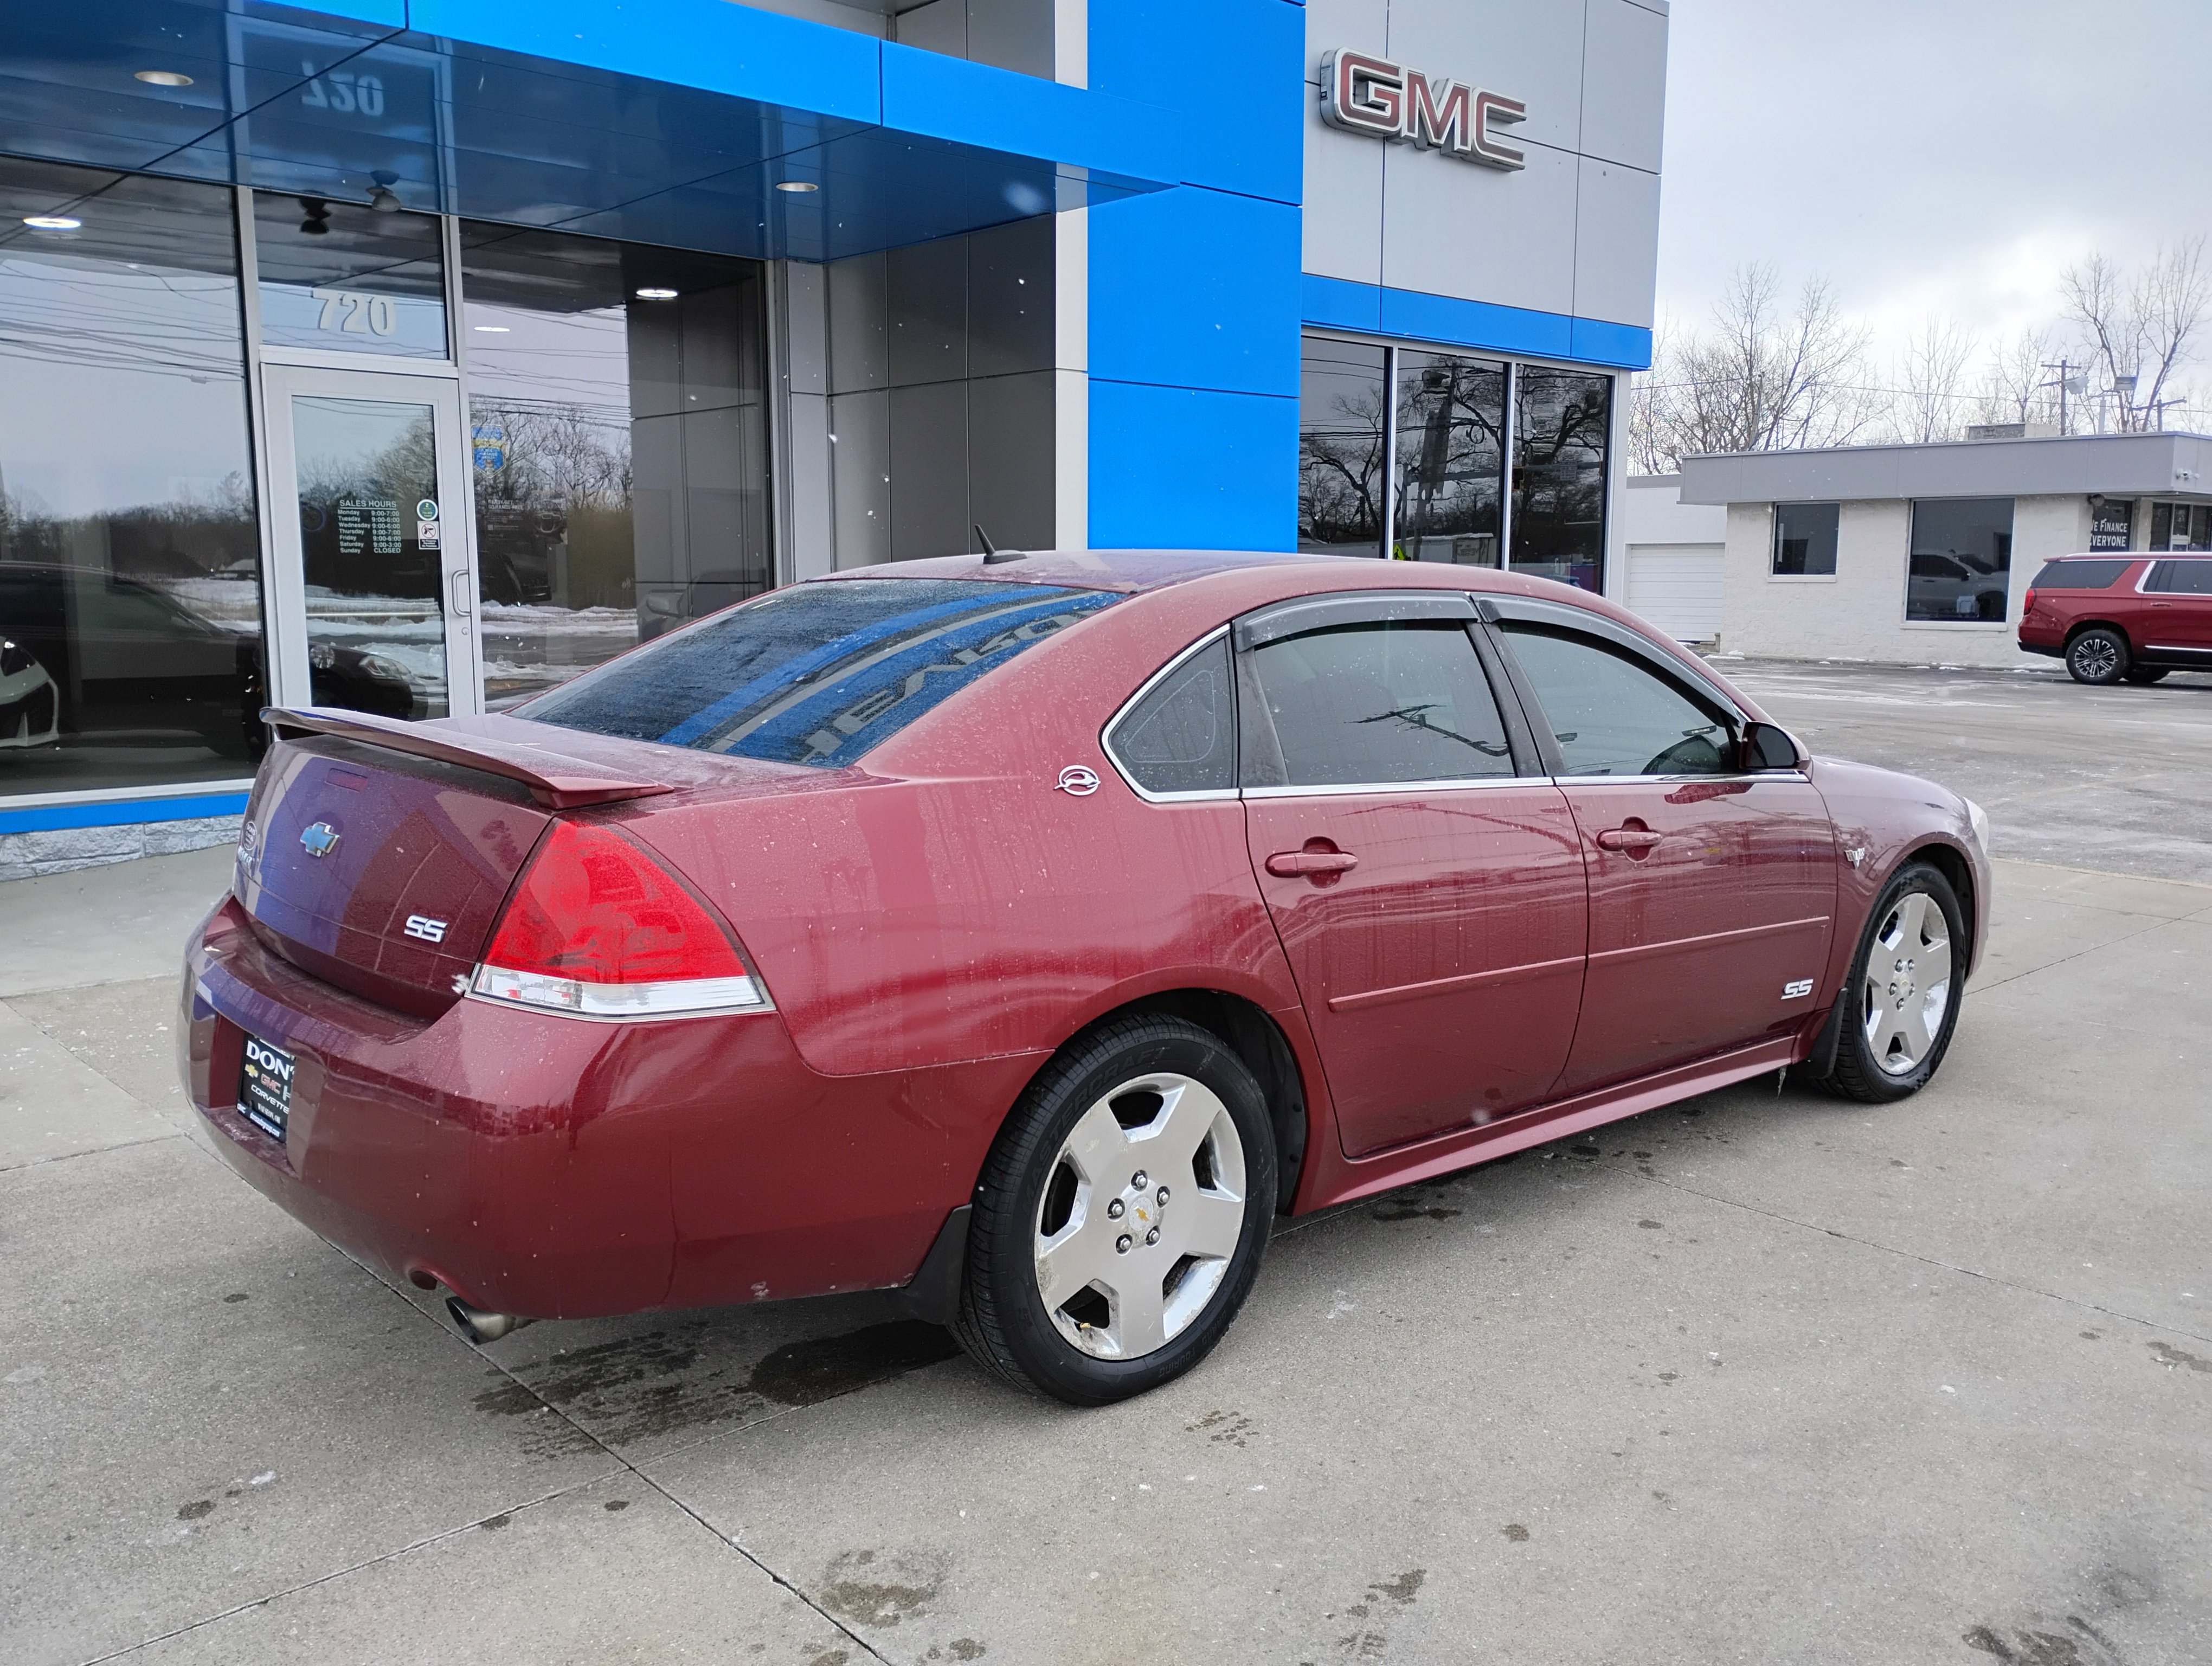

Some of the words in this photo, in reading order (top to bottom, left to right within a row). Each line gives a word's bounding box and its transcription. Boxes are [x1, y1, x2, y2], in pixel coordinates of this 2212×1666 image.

[1323, 47, 1526, 171] GMC
[313, 290, 396, 337] 720
[2100, 518, 2127, 533] FINANCE
[404, 915, 448, 943] SS
[1780, 978, 1814, 1000] SS
[251, 1084, 290, 1114] CORVETTE
